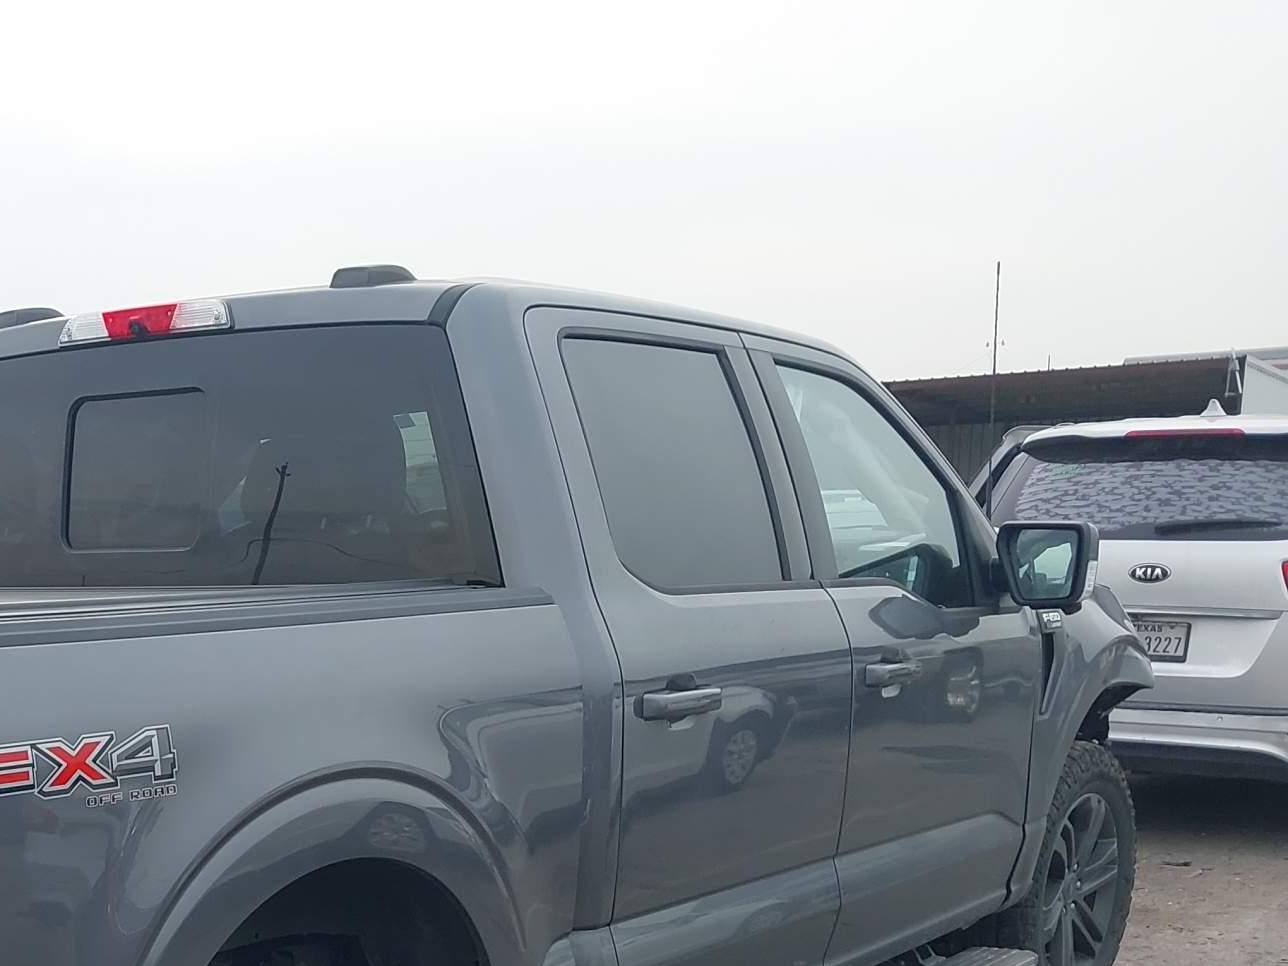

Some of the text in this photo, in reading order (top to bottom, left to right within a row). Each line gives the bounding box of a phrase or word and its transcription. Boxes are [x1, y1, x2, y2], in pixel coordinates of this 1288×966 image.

[1135, 567, 1163, 579] KIA
[86, 784, 178, 808] OFF ROAD
